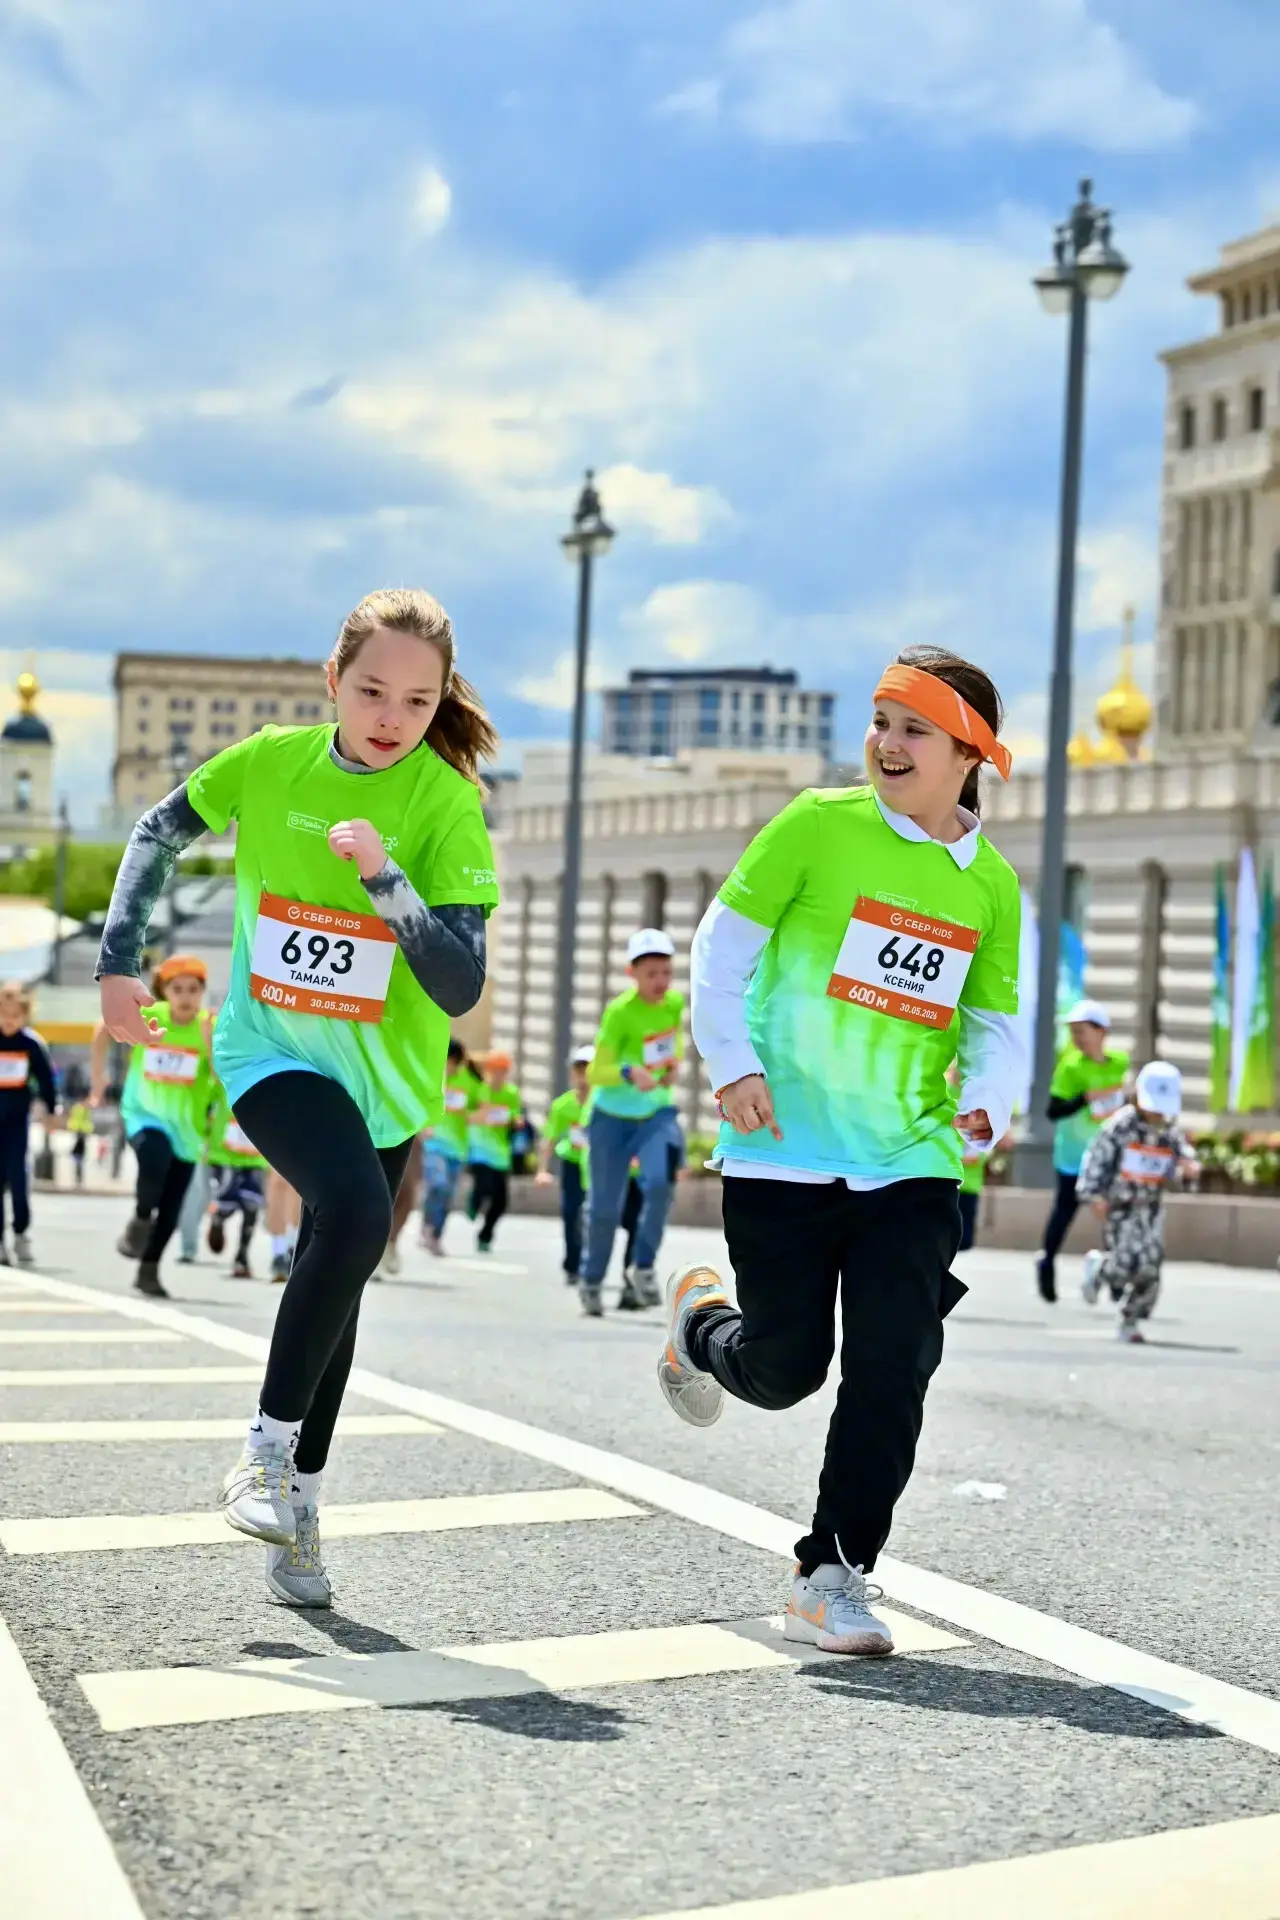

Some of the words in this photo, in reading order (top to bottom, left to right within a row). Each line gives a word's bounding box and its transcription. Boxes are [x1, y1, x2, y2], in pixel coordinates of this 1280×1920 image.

[303, 911, 333, 925] СБЕР
[334, 917, 361, 930] KIDS
[904, 918, 931, 933] СБЕР
[932, 926, 953, 940] KIDS
[280, 930, 355, 975] 693
[877, 935, 945, 982] 648
[290, 969, 336, 988] ТАМАРА
[883, 973, 925, 995] КСЕНИЯ
[261, 983, 284, 1004] 600
[848, 984, 876, 1006] 600
[310, 998, 361, 1014] 30.05.2026
[900, 1002, 938, 1021] 30.05.2026
